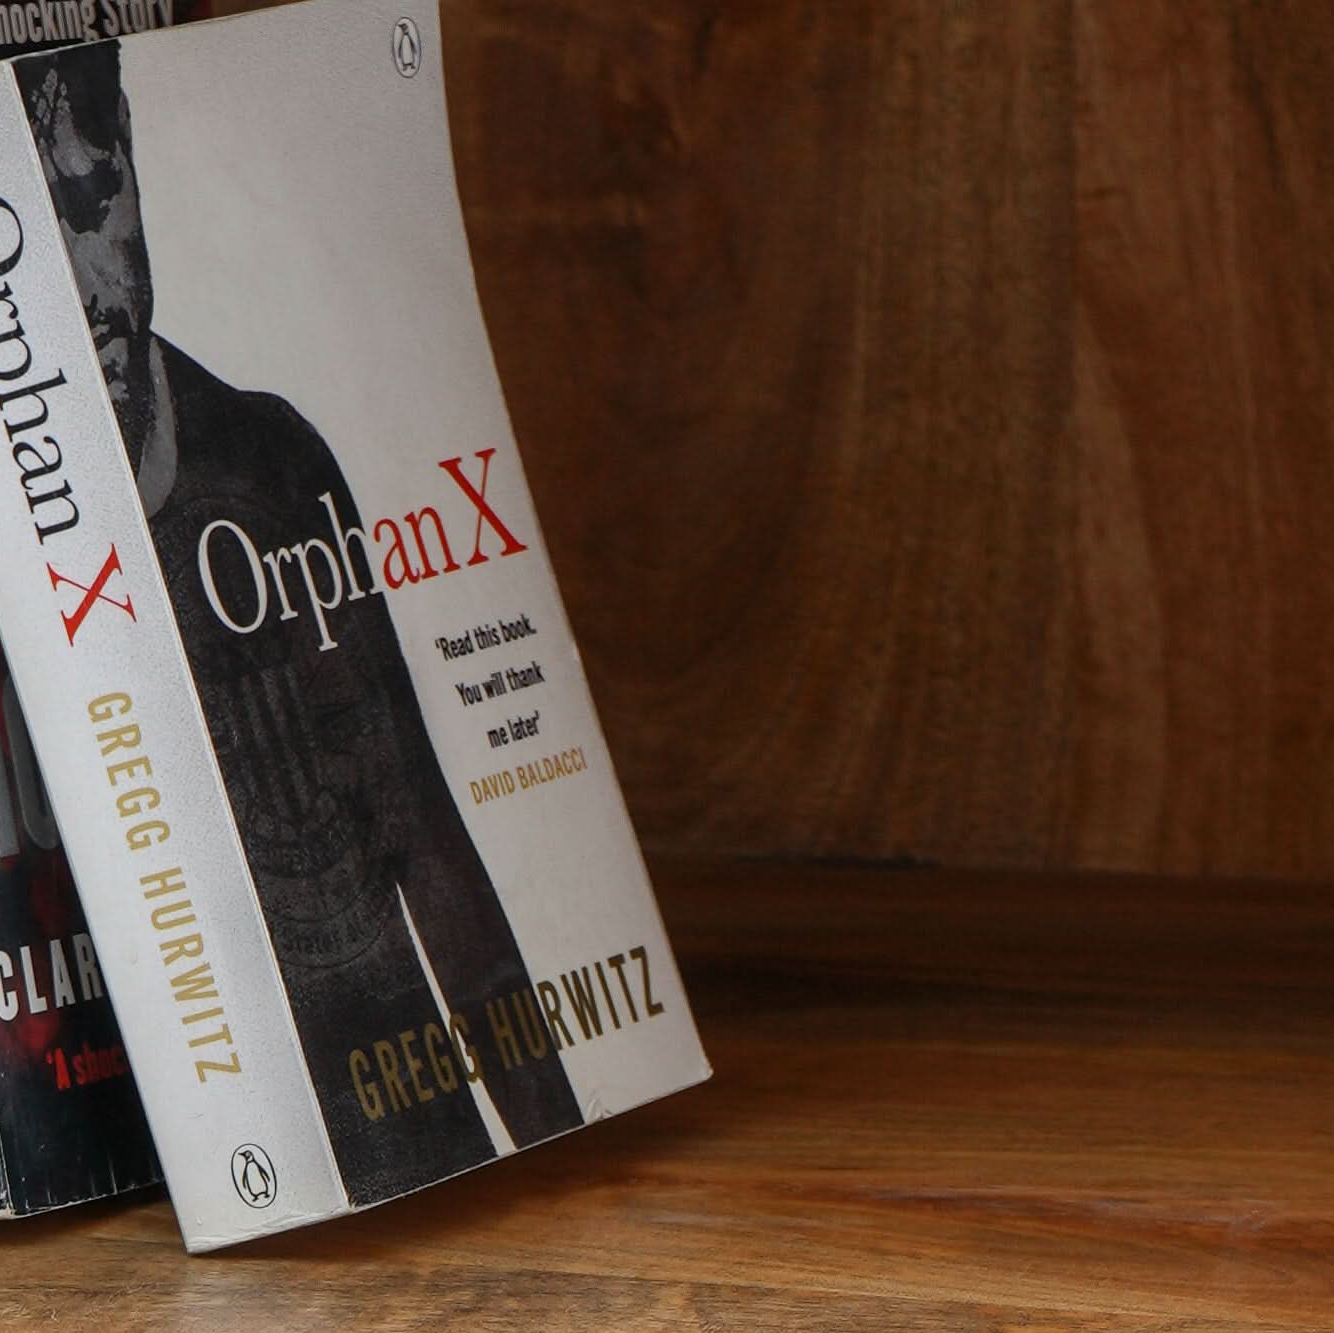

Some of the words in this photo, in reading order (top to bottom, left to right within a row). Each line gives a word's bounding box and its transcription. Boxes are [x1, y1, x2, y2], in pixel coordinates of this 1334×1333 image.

[198, 489, 461, 652] Orphan
[438, 448, 529, 567] X
[47, 542, 136, 646] X
[474, 624, 500, 652] this
[455, 678, 483, 707] You
[482, 671, 507, 700] will
[506, 661, 545, 694] thank
[470, 772, 517, 806] DAVID
[516, 745, 588, 793] BALDACCI
[487, 727, 507, 749] me
[88, 692, 171, 852] GREGG
[139, 866, 242, 1084] HURWITZ
[348, 1011, 483, 1121] GREGG
[492, 945, 665, 1072] HURWITZ
